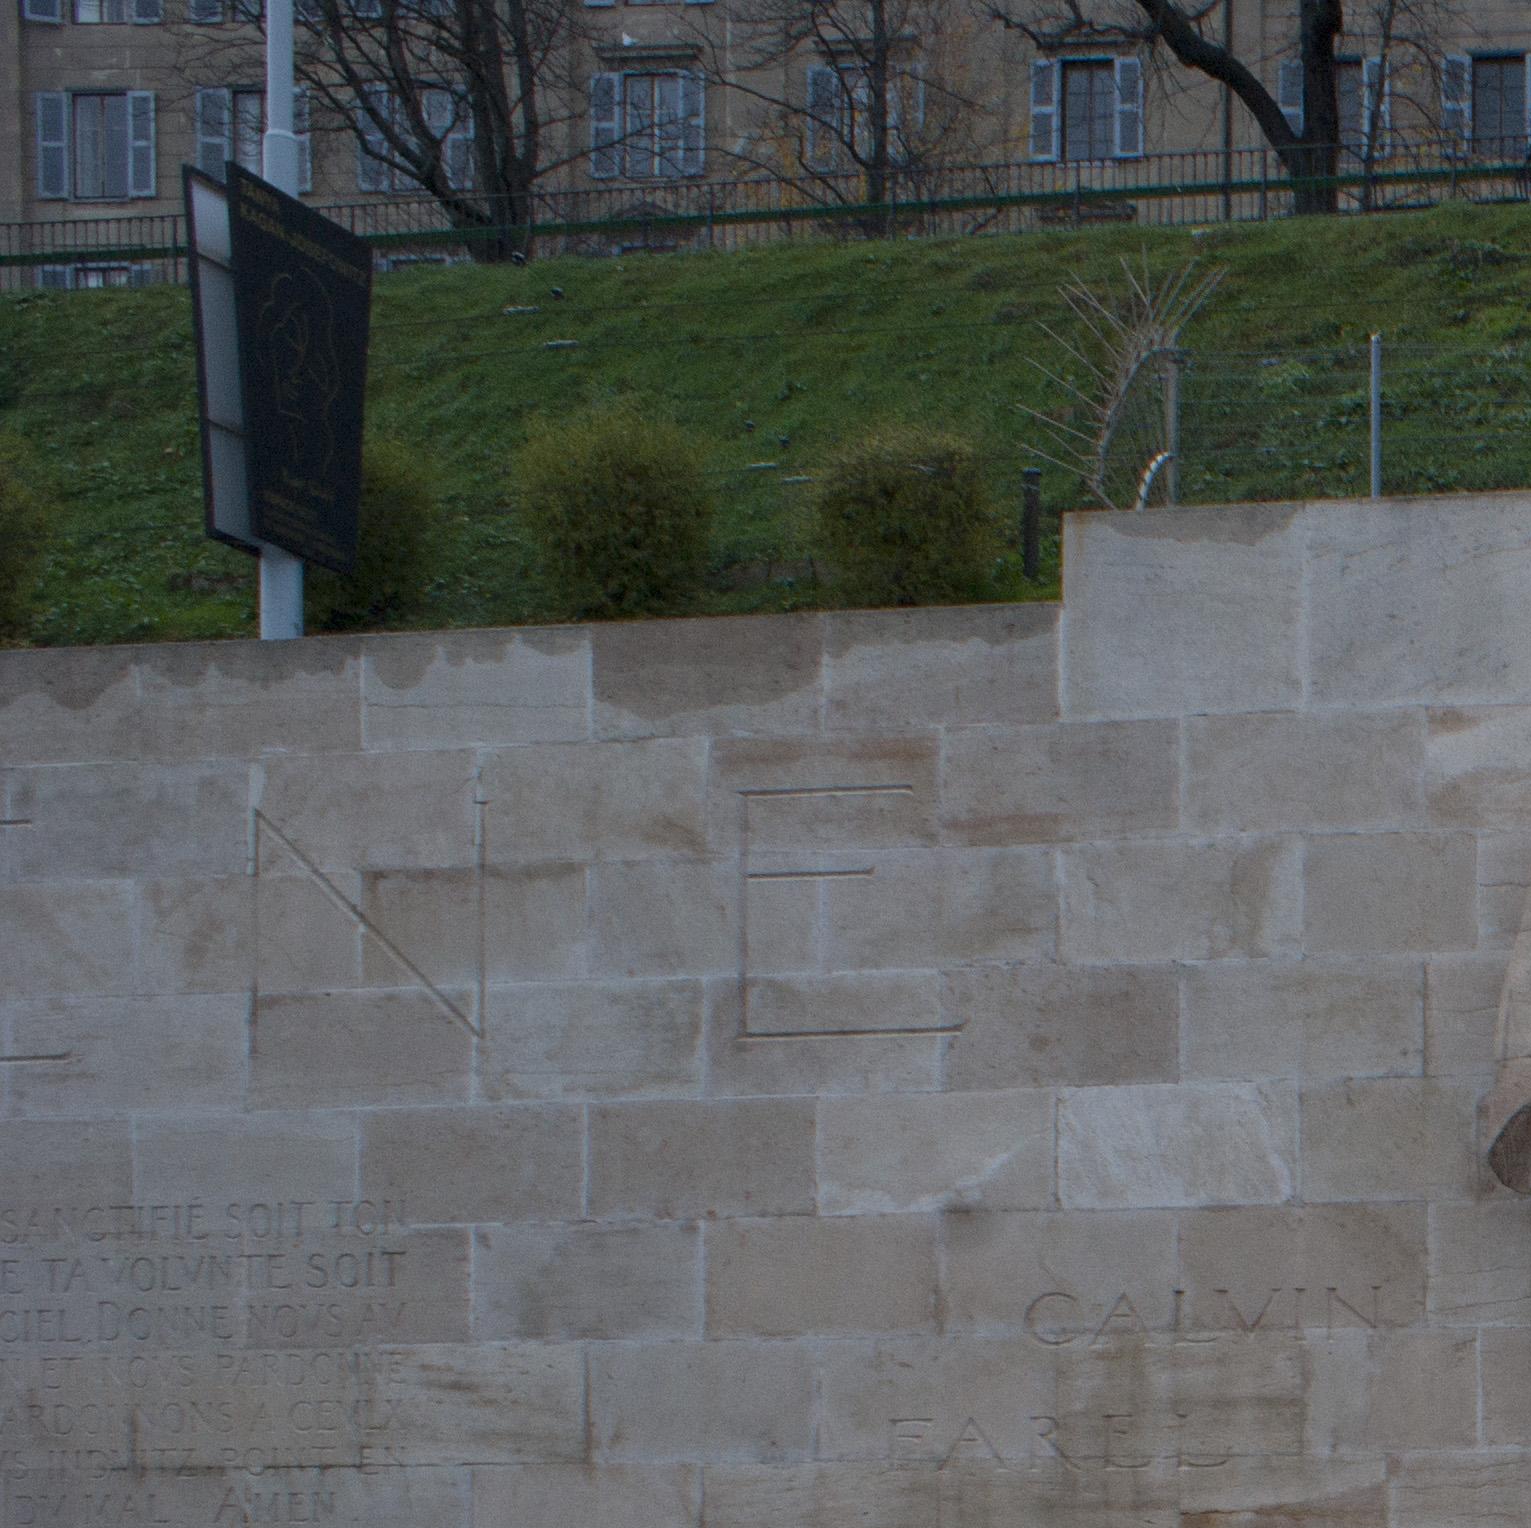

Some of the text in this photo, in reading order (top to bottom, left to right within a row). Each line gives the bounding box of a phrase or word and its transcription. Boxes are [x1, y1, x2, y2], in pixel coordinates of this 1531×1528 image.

[225, 1200, 314, 1240] SOIT
[330, 1198, 407, 1238] TON
[41, 1257, 91, 1294] TA
[305, 1249, 408, 1289] SOIT
[98, 1300, 234, 1342] DONNE
[246, 1302, 343, 1339] NOVS
[356, 1301, 408, 1337] AV
[1023, 1283, 1383, 1347] CALVIN
[102, 1353, 197, 1390] NOVS
[215, 1350, 408, 1388] PARDONNE
[888, 1413, 1229, 1472] FAREL
